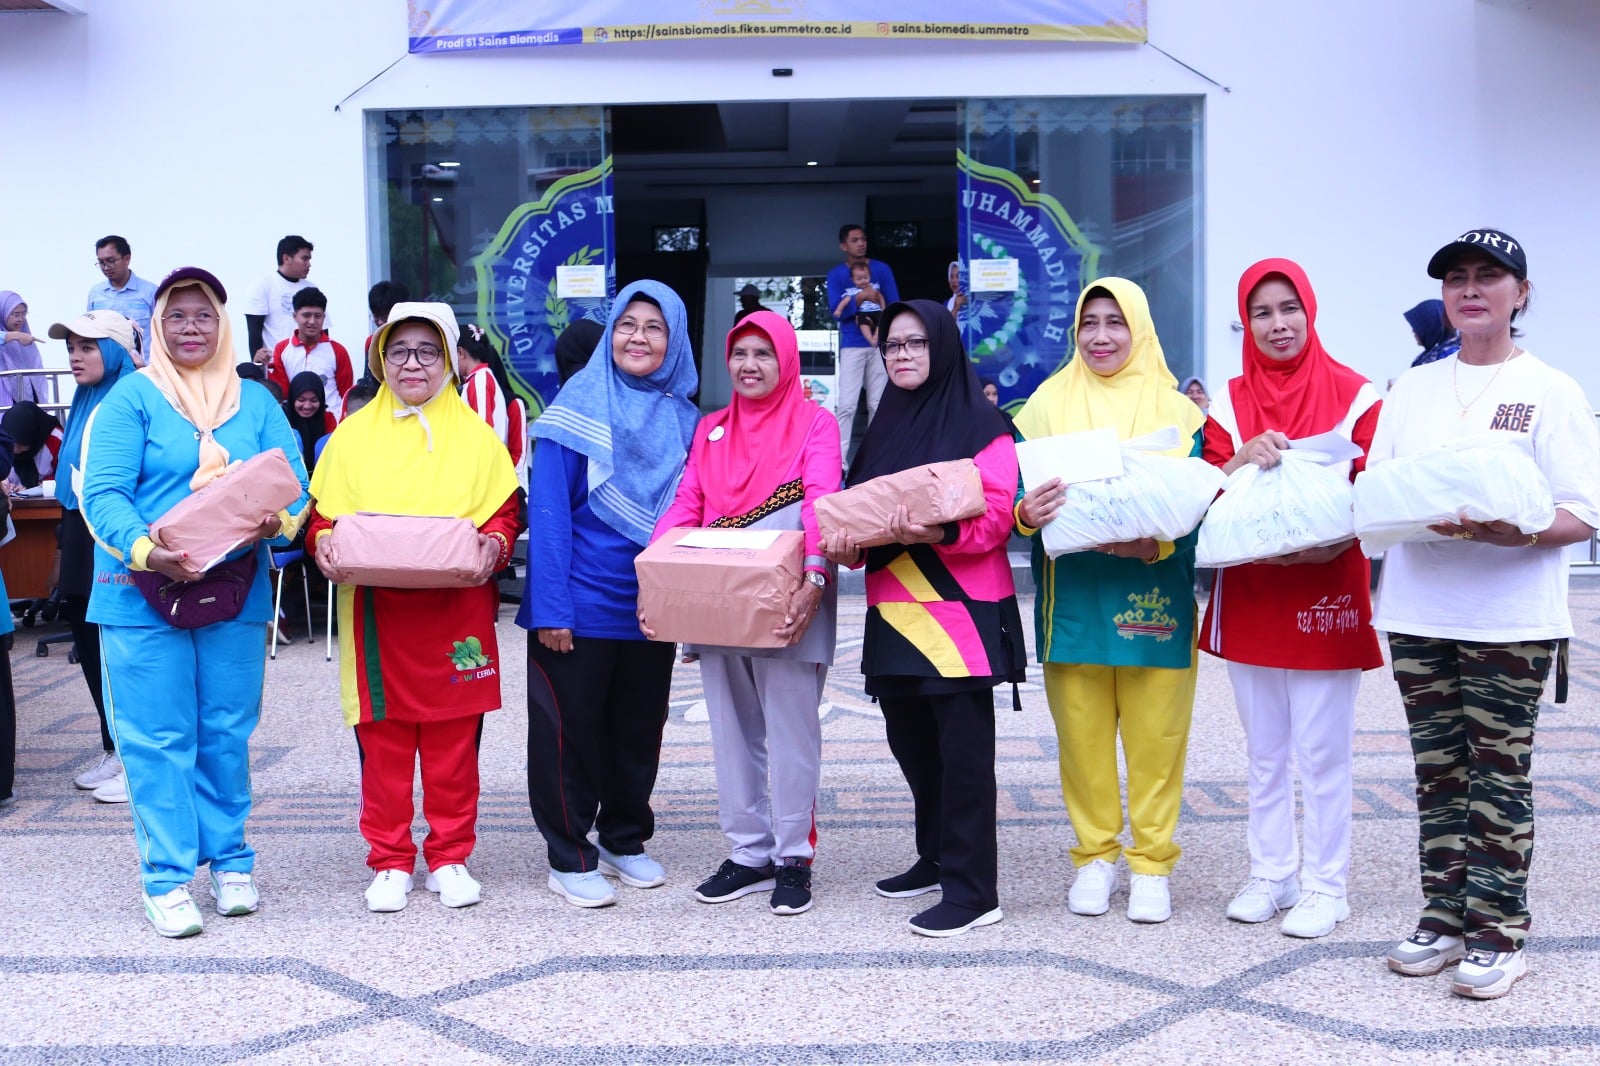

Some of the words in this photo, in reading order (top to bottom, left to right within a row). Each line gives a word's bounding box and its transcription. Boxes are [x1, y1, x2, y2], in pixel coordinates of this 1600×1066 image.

[613, 23, 852, 40] https://sainsbiomedis.fikes.ummetro.ac.id
[892, 24, 1030, 36] sains.biomedis.ummetro
[436, 38, 464, 49] Prodi
[466, 37, 476, 47] S1
[478, 36, 508, 47] Sains
[509, 33, 560, 45] Biomedis
[1457, 232, 1518, 256] ORT
[506, 200, 588, 355] UNIVERSITAS
[1495, 402, 1536, 418] SERE
[1489, 415, 1532, 434] NADE
[450, 671, 476, 684] SWI
[476, 667, 497, 679] CERIA
